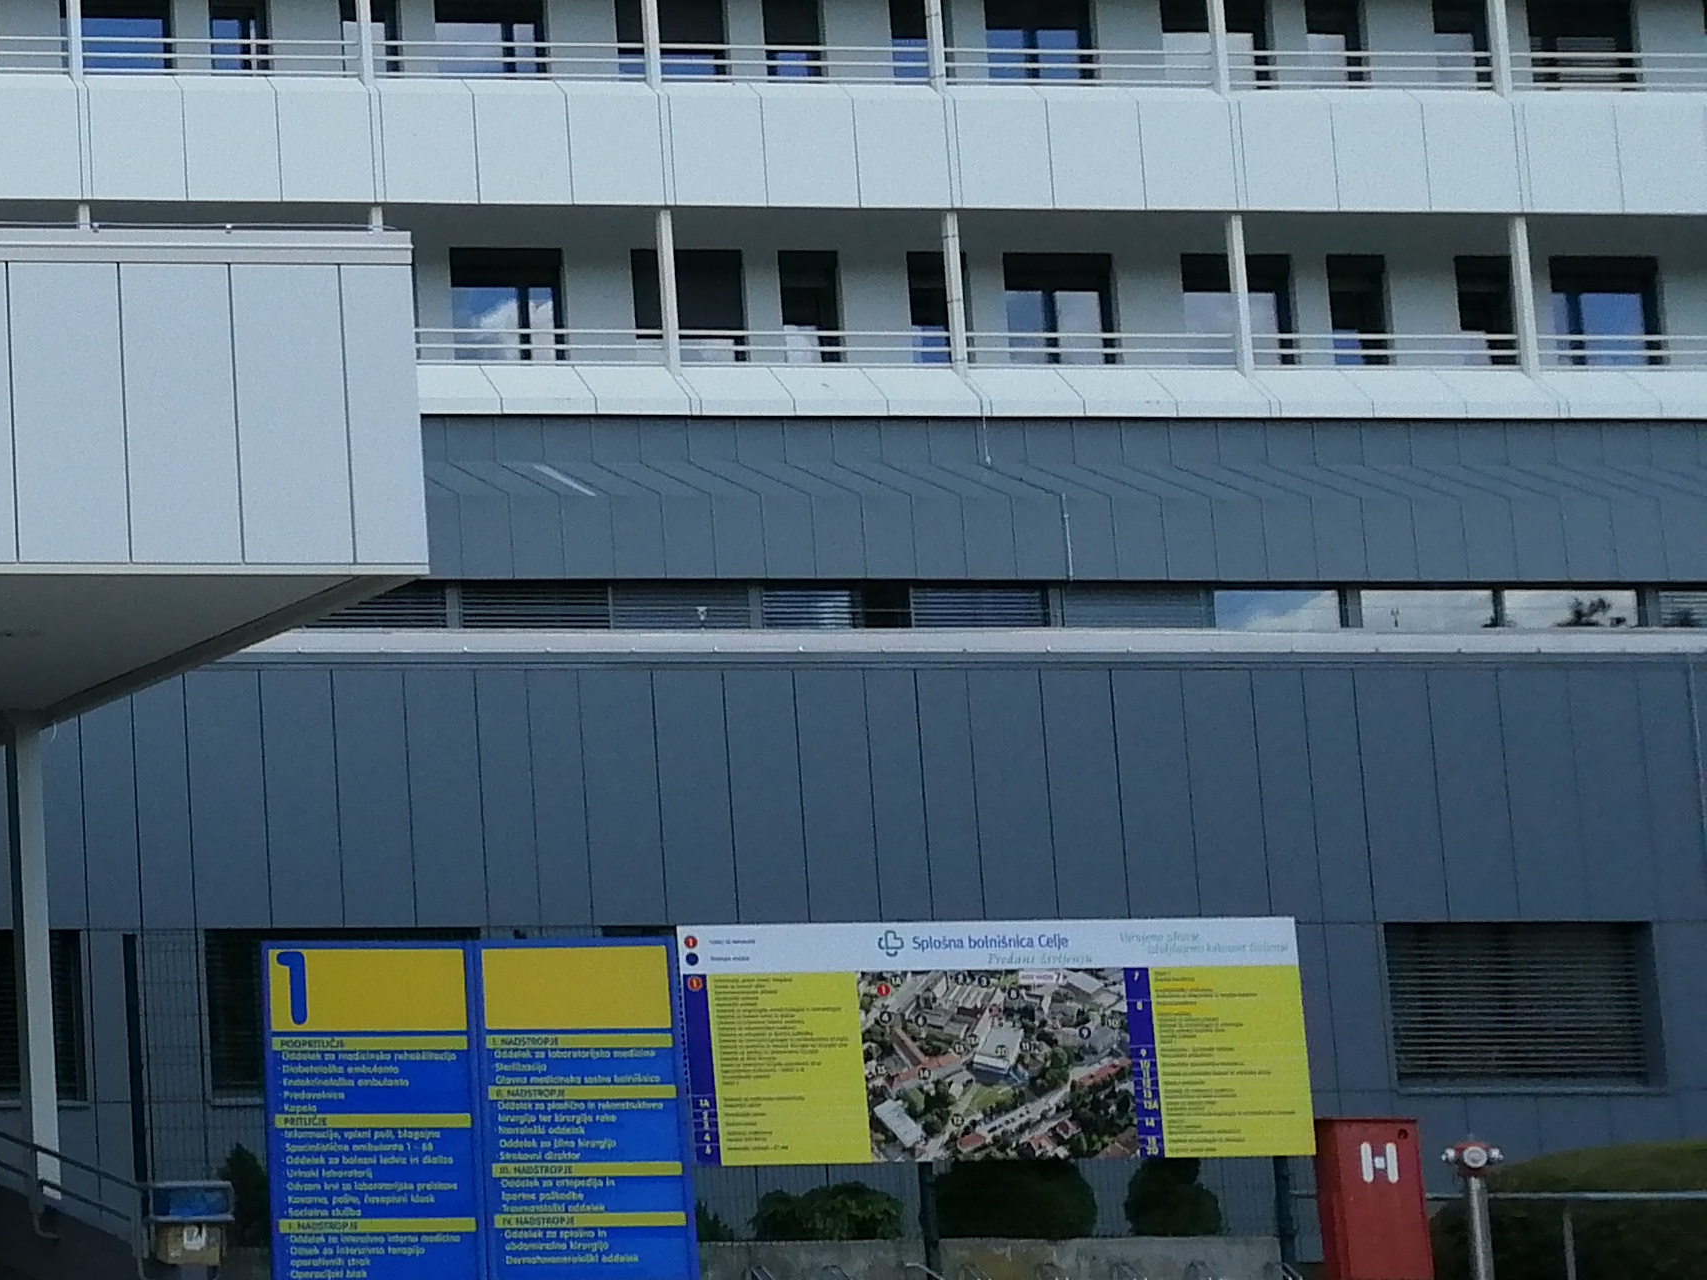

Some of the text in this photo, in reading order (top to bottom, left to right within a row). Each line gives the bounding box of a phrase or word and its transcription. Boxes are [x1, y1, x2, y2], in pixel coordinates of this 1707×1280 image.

[912, 934, 1068, 953] Splošna bolnišnica Celje
[276, 951, 308, 1026] 1
[1360, 1141, 1399, 1184] H
